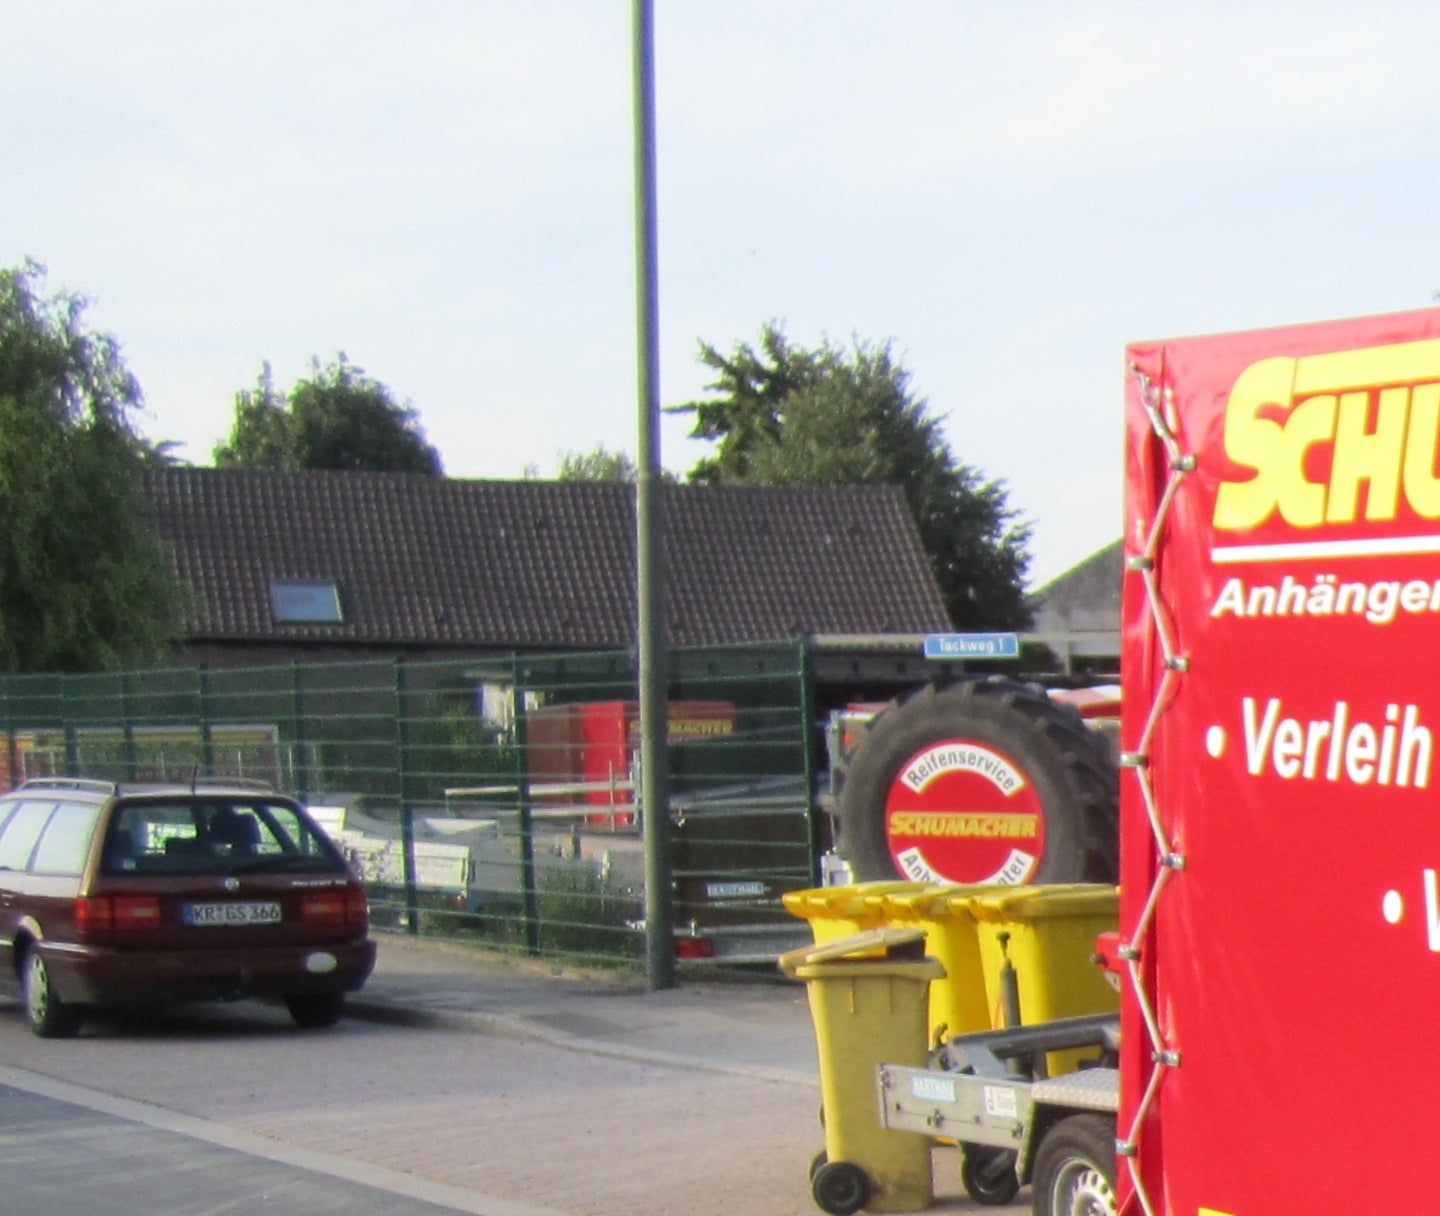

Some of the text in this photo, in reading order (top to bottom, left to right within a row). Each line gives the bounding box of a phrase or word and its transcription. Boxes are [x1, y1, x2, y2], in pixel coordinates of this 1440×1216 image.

[1241, 695, 1433, 789] Verleih
[906, 751, 1015, 790] Reifenservice
[889, 811, 1038, 838] SCHUMACHER
[194, 906, 217, 921] KR
[226, 906, 247, 920] GS
